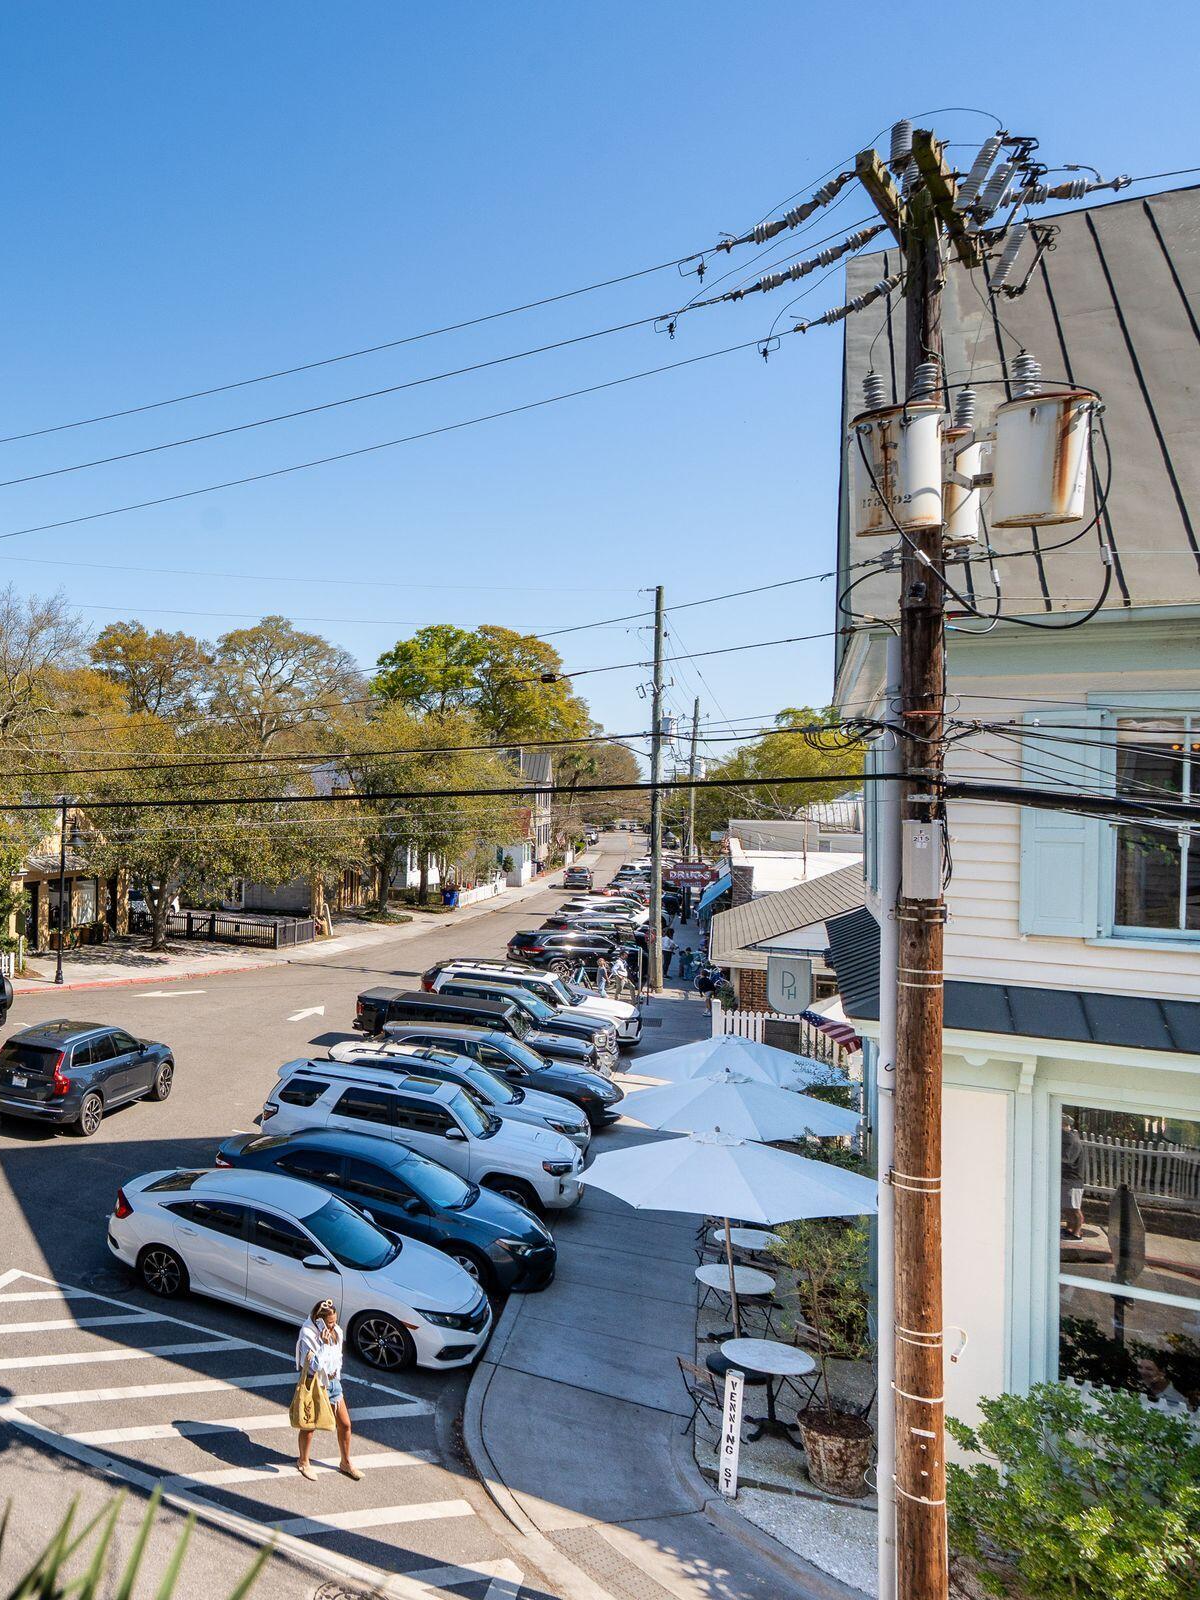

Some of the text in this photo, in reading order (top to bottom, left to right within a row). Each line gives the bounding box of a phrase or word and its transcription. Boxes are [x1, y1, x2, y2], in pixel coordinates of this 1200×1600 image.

[669, 870, 711, 880] DRUGS
[724, 1380, 738, 1489] VENNING ST
